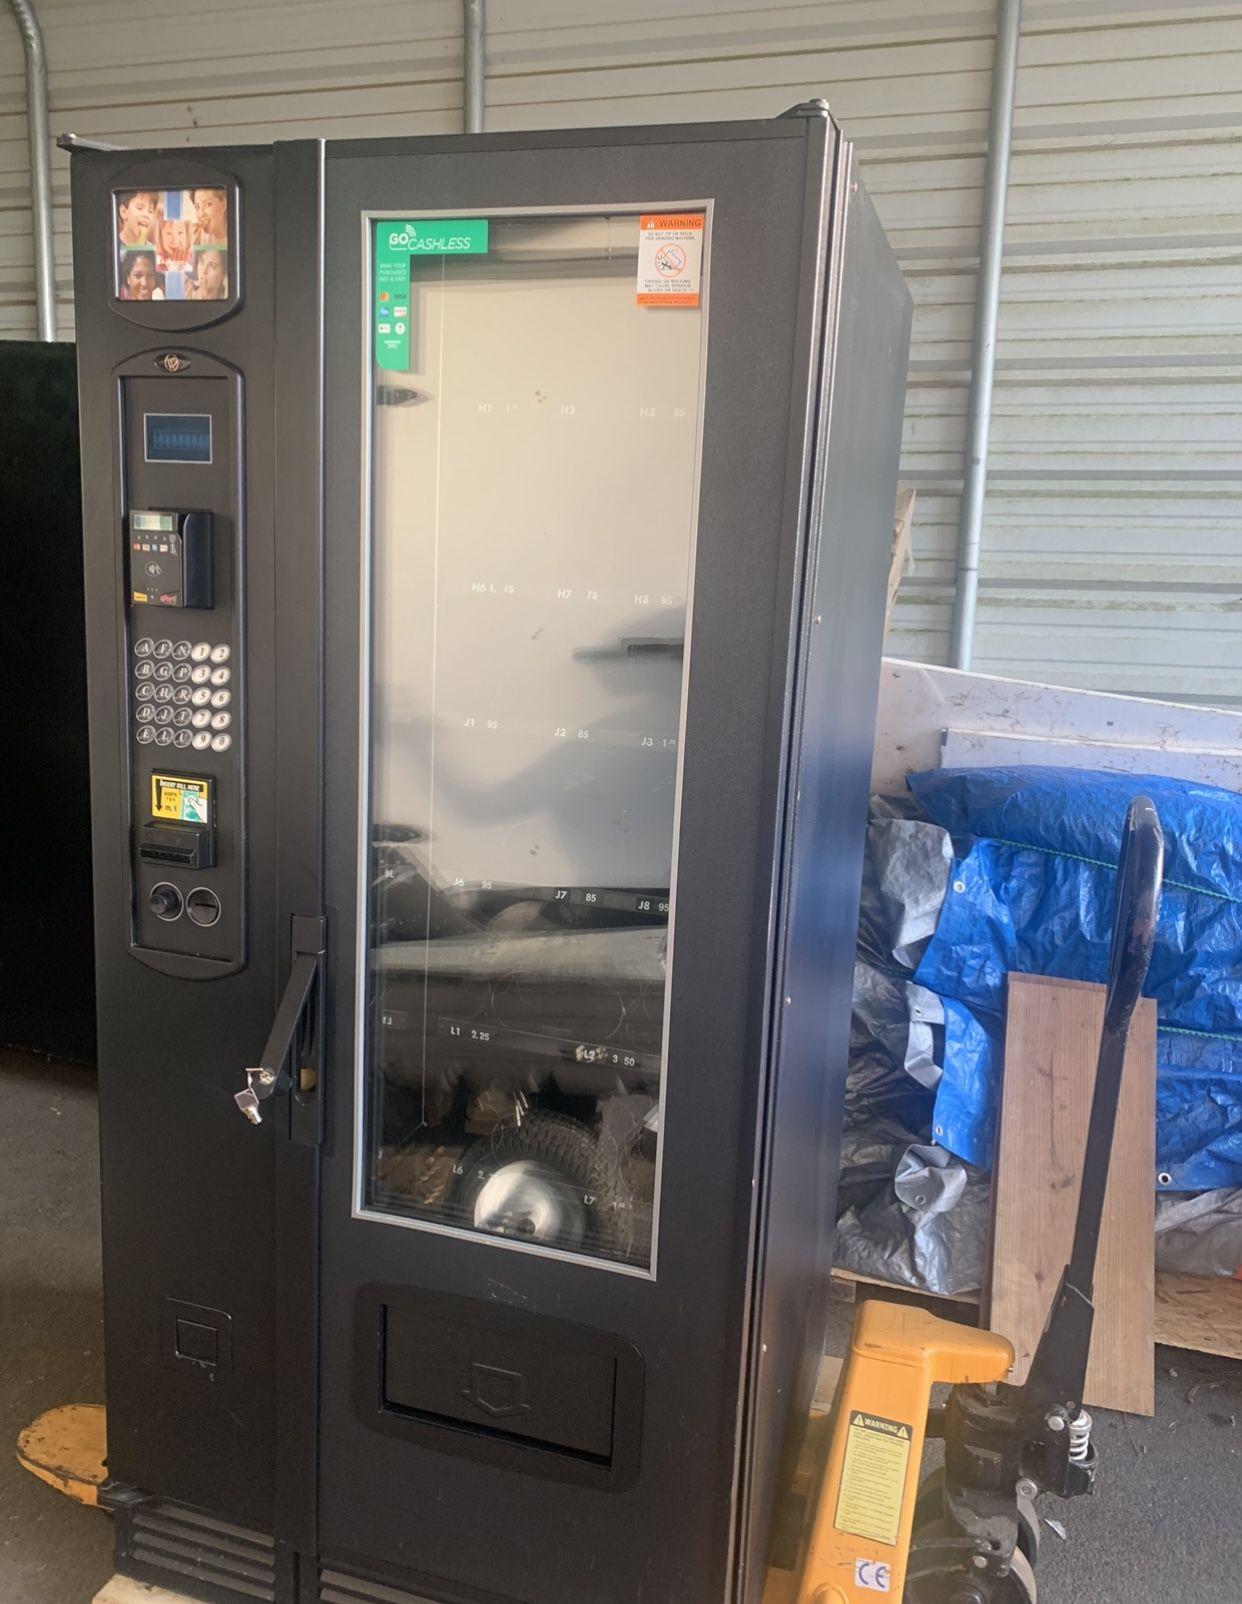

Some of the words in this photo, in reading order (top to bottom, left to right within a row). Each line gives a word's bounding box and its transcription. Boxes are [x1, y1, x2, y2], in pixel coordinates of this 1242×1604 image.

[660, 219, 701, 227] WARNING
[389, 233, 409, 245] GO
[407, 237, 471, 250] CASHLESS
[560, 405, 576, 416] H2
[640, 407, 656, 417] H3
[557, 589, 572, 599] H7
[587, 591, 598, 601] 75
[464, 718, 475, 727] J1
[554, 727, 567, 737] J2
[640, 736, 654, 747] J3
[159, 779, 176, 789] INSERT
[176, 782, 188, 790] BILL
[187, 783, 200, 792] HERE
[453, 878, 464, 887] J6
[481, 880, 493, 890] 95
[555, 890, 568, 900] J7
[585, 892, 597, 903] 85
[638, 900, 650, 911] J8
[658, 903, 670, 912] 95
[450, 1026, 461, 1036] L1
[471, 1030, 490, 1041] 2.25
[612, 1054, 619, 1064] 3
[623, 1056, 635, 1067] 50
[452, 1164, 464, 1175] L6
[584, 1194, 596, 1205] L7
[864, 1417, 898, 1433] WARNING
[858, 1562, 887, 1589] CE
